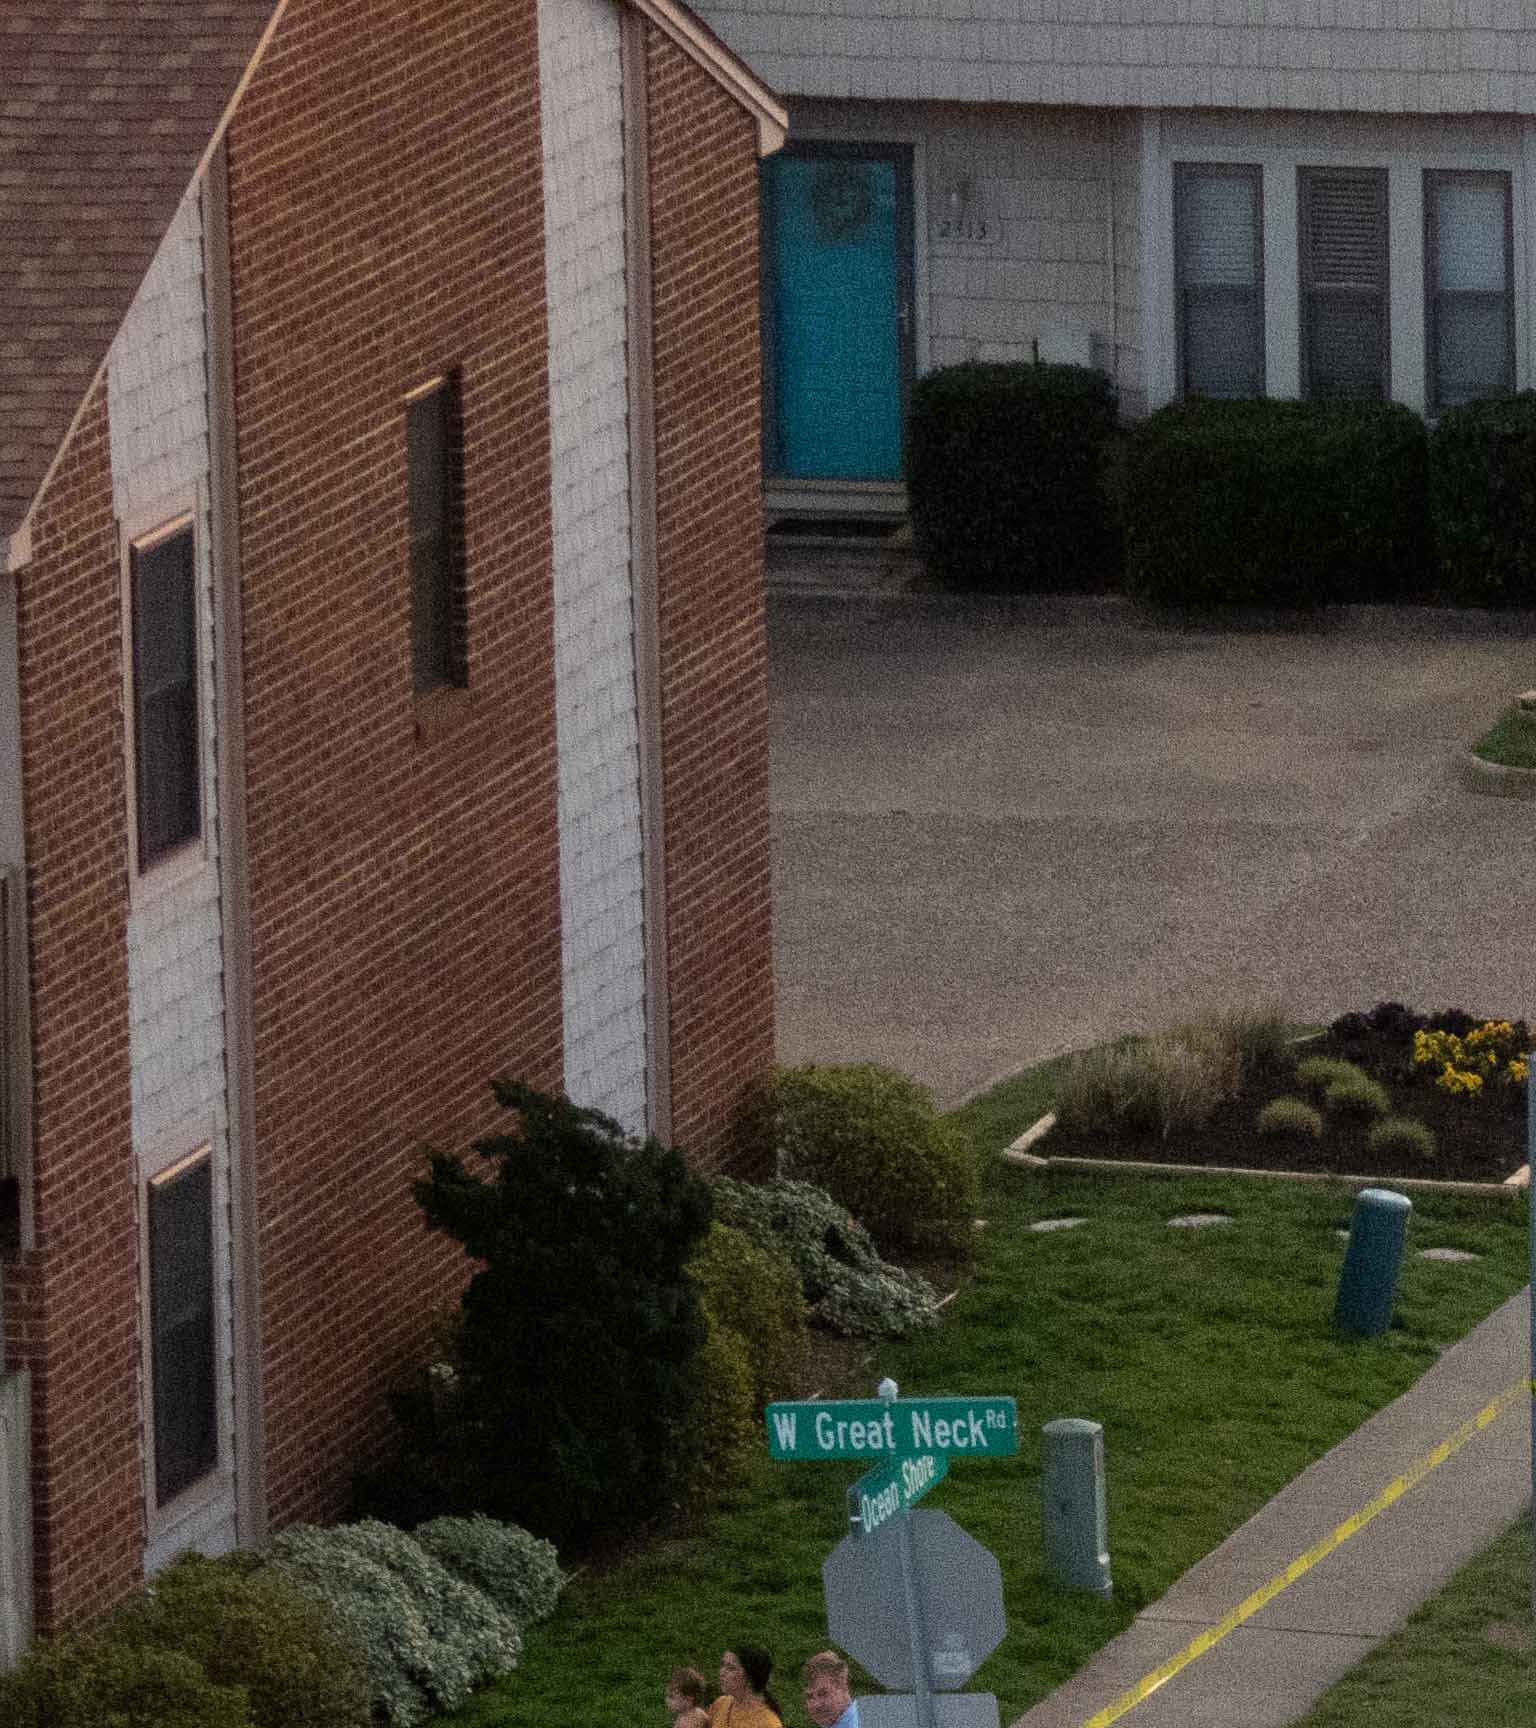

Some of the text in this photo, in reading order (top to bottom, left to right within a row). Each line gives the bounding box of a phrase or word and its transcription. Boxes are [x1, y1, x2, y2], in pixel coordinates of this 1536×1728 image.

[773, 1409, 1006, 1451] W Great Neck Rd
[861, 1455, 935, 1533] Ocean Shore
